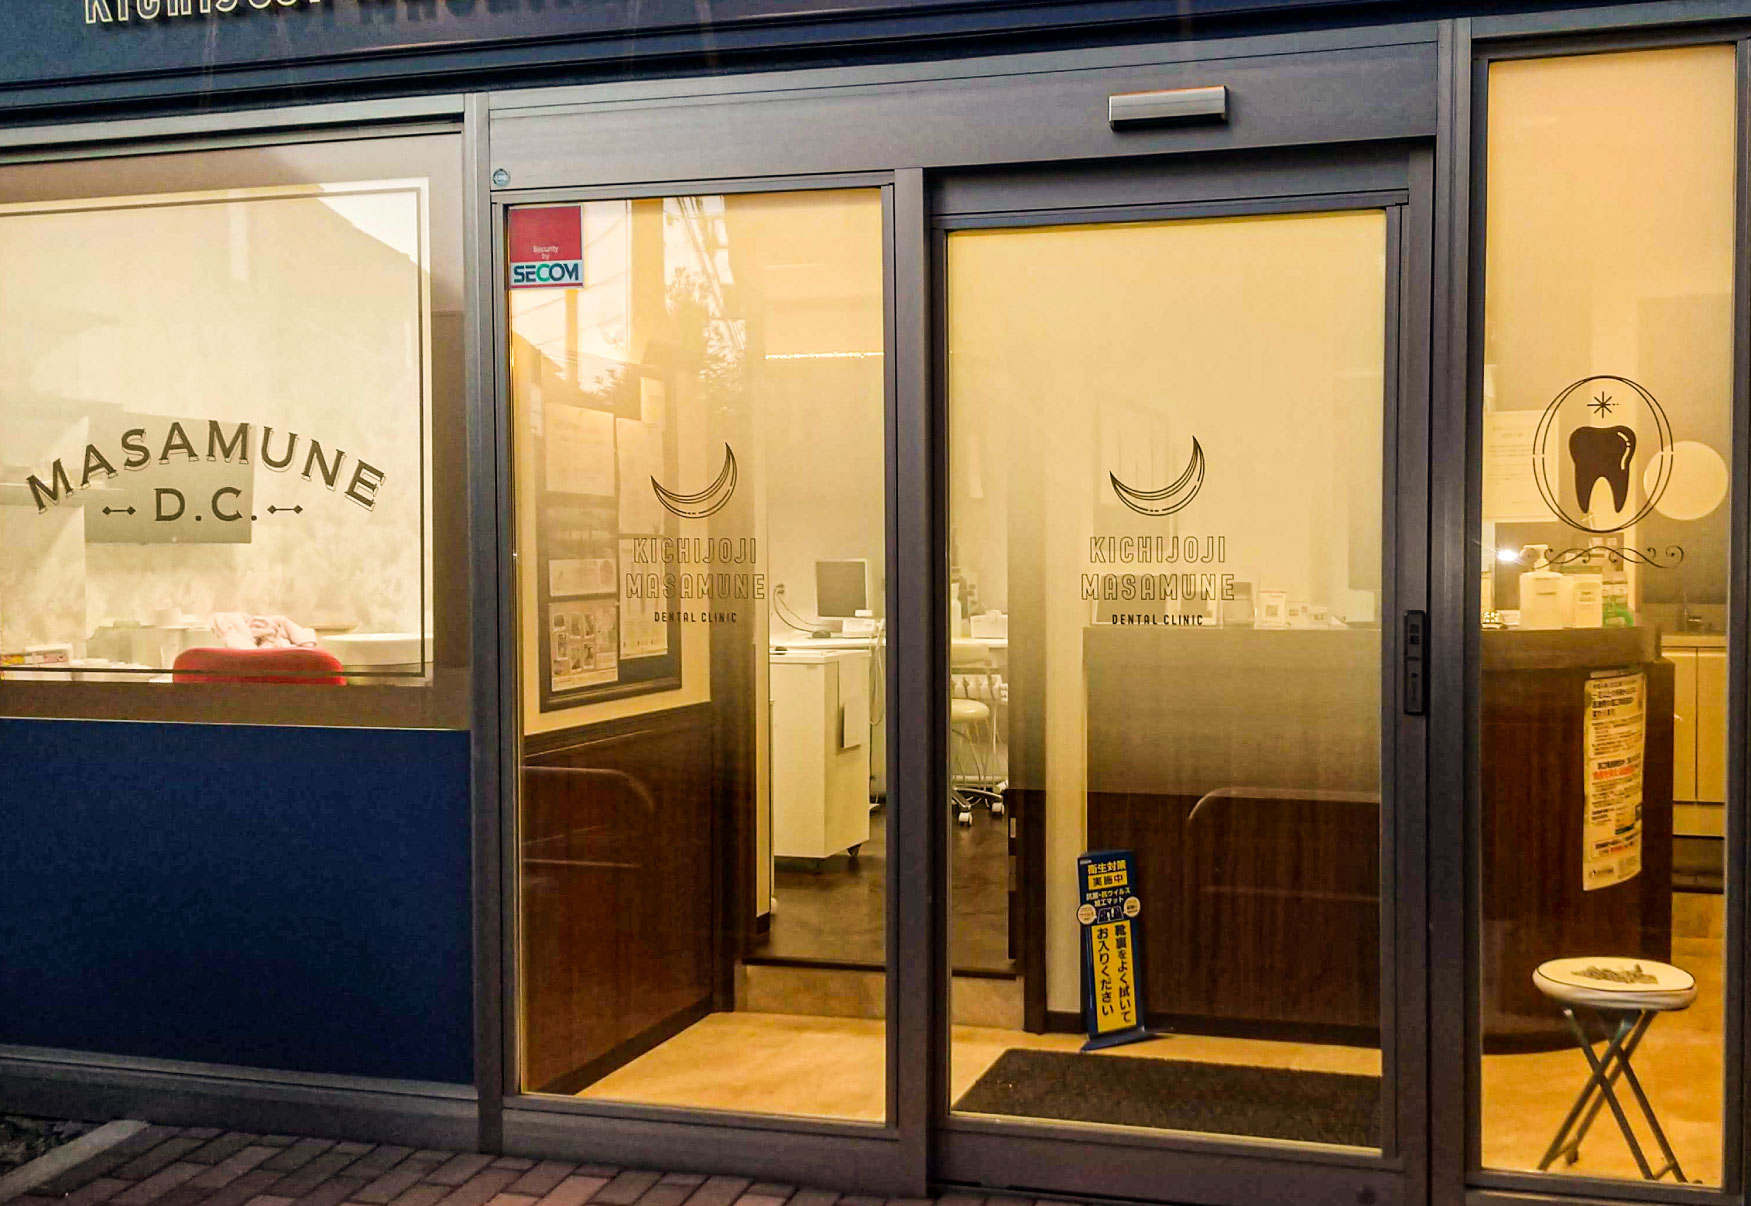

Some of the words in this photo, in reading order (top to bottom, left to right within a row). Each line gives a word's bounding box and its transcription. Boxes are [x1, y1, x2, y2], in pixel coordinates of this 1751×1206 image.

[533, 245, 559, 254] Security
[541, 252, 550, 260] by
[513, 263, 579, 283] SECOM
[26, 420, 387, 515] MASAMUNE
[154, 486, 258, 522] D.C.
[633, 537, 757, 564] KICHIJOJI
[1089, 536, 1226, 563] KICHIJOJI
[625, 573, 766, 600] MASAMUNE
[1081, 573, 1236, 600] MASAMUNE
[654, 611, 697, 623] DENTAL
[701, 611, 738, 623] CLINIC
[1112, 613, 1158, 625] DENTAL
[1163, 613, 1204, 625] CLINIC
[1092, 874, 1124, 887] 実施中
[1096, 927, 1115, 1016] お入りください
